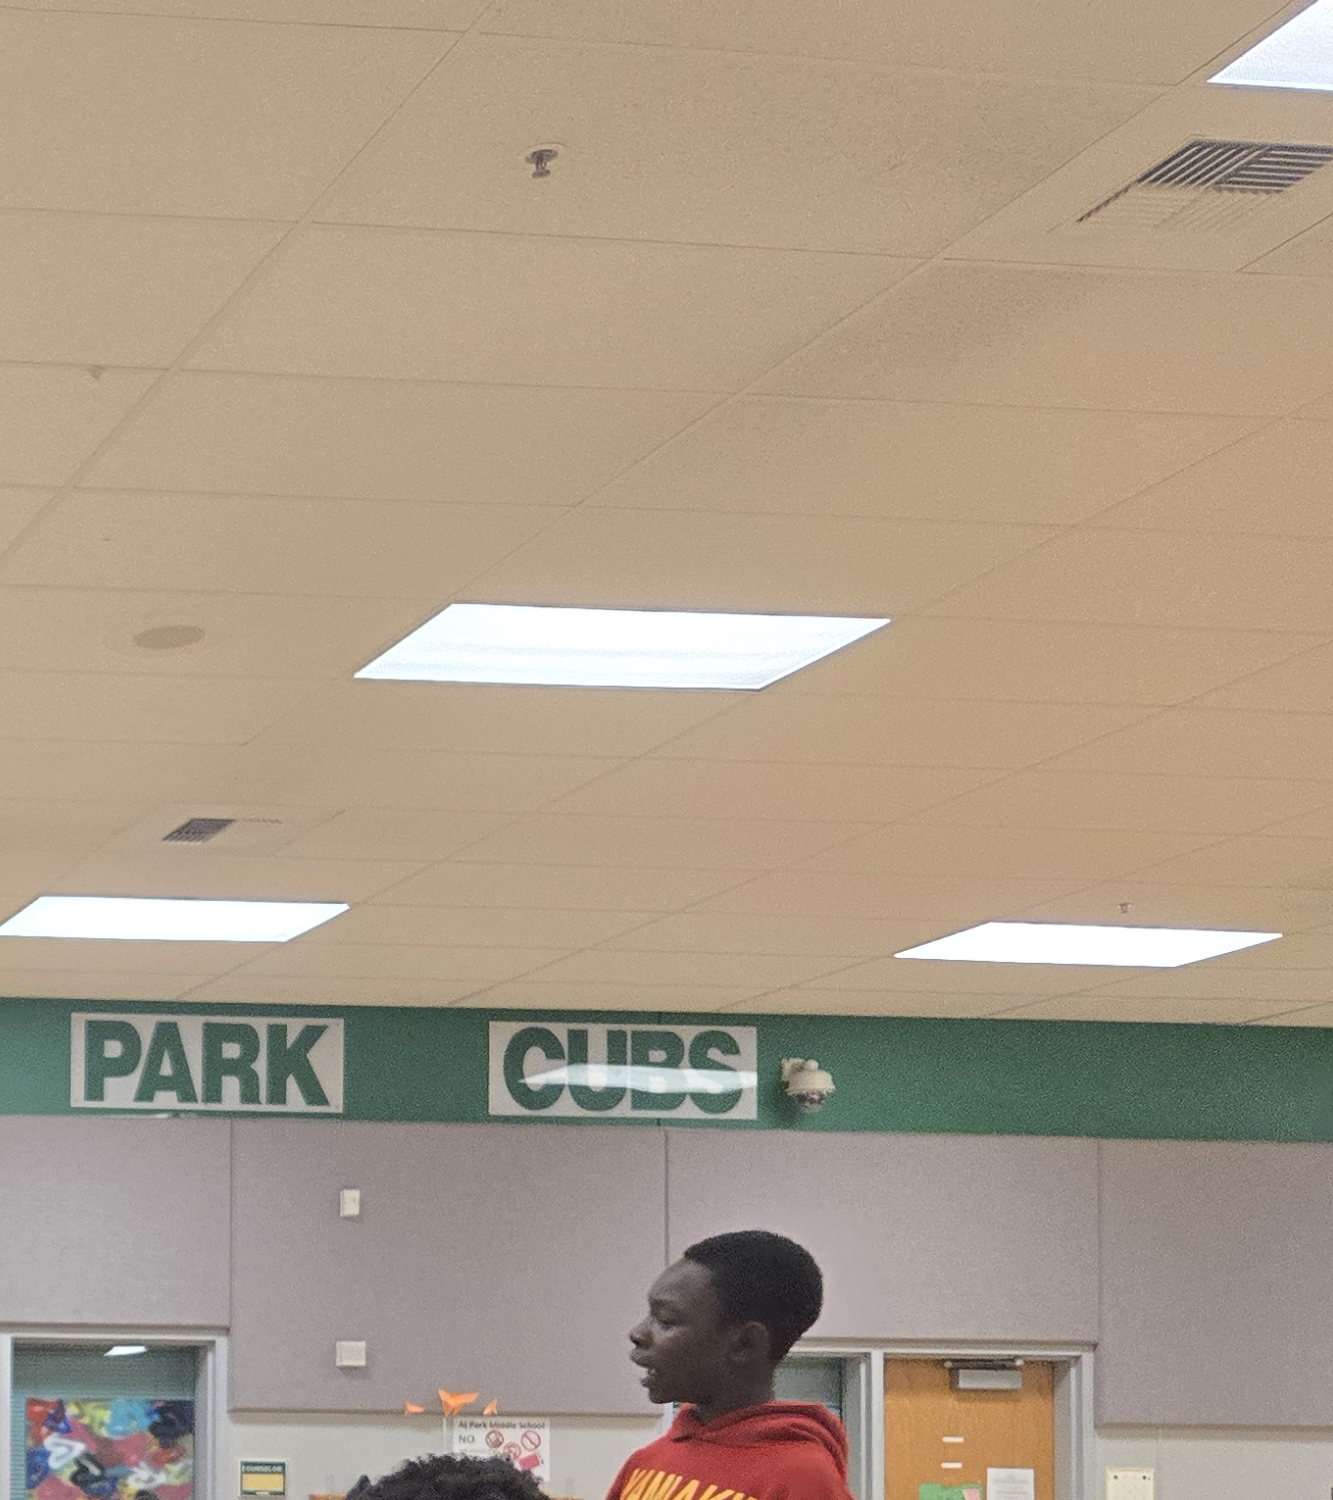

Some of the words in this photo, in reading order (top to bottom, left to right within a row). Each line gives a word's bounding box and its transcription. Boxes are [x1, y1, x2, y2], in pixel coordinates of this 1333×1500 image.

[84, 1018, 331, 1106] PARK
[502, 1026, 743, 1114] CUBS
[458, 1434, 476, 1445] NO
[469, 1420, 487, 1429] Park
[488, 1420, 517, 1429] Middle
[518, 1421, 546, 1430] School
